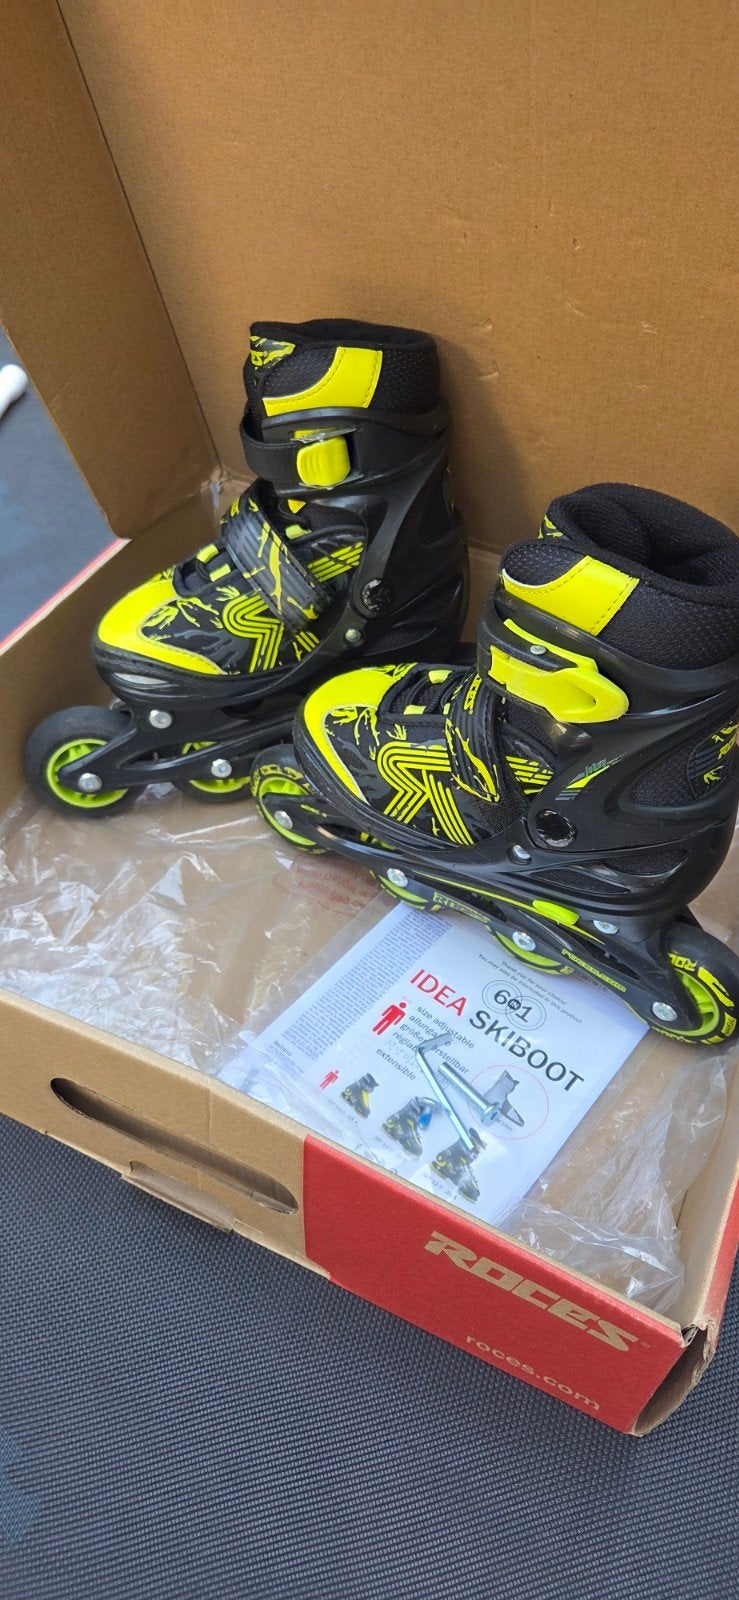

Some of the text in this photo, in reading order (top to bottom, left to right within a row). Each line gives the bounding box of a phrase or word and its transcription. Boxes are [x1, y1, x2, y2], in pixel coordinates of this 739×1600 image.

[479, 953, 488, 962] You
[487, 960, 499, 970] may
[500, 967, 510, 977] also
[518, 979, 545, 999] interested
[550, 1000, 560, 1010] this
[560, 1009, 583, 1024] product
[502, 961, 517, 972] Thank
[517, 972, 527, 980] you
[527, 976, 535, 984] for
[535, 984, 548, 992] your
[408, 1015, 452, 1047] allungae
[410, 969, 467, 1017] IDEA
[469, 1009, 585, 1091] SKIBOOT
[416, 1006, 475, 1049] size adjustable
[376, 1048, 417, 1081] extensible
[424, 1230, 639, 1352] ROCES
[466, 1335, 600, 1411] roces.com
